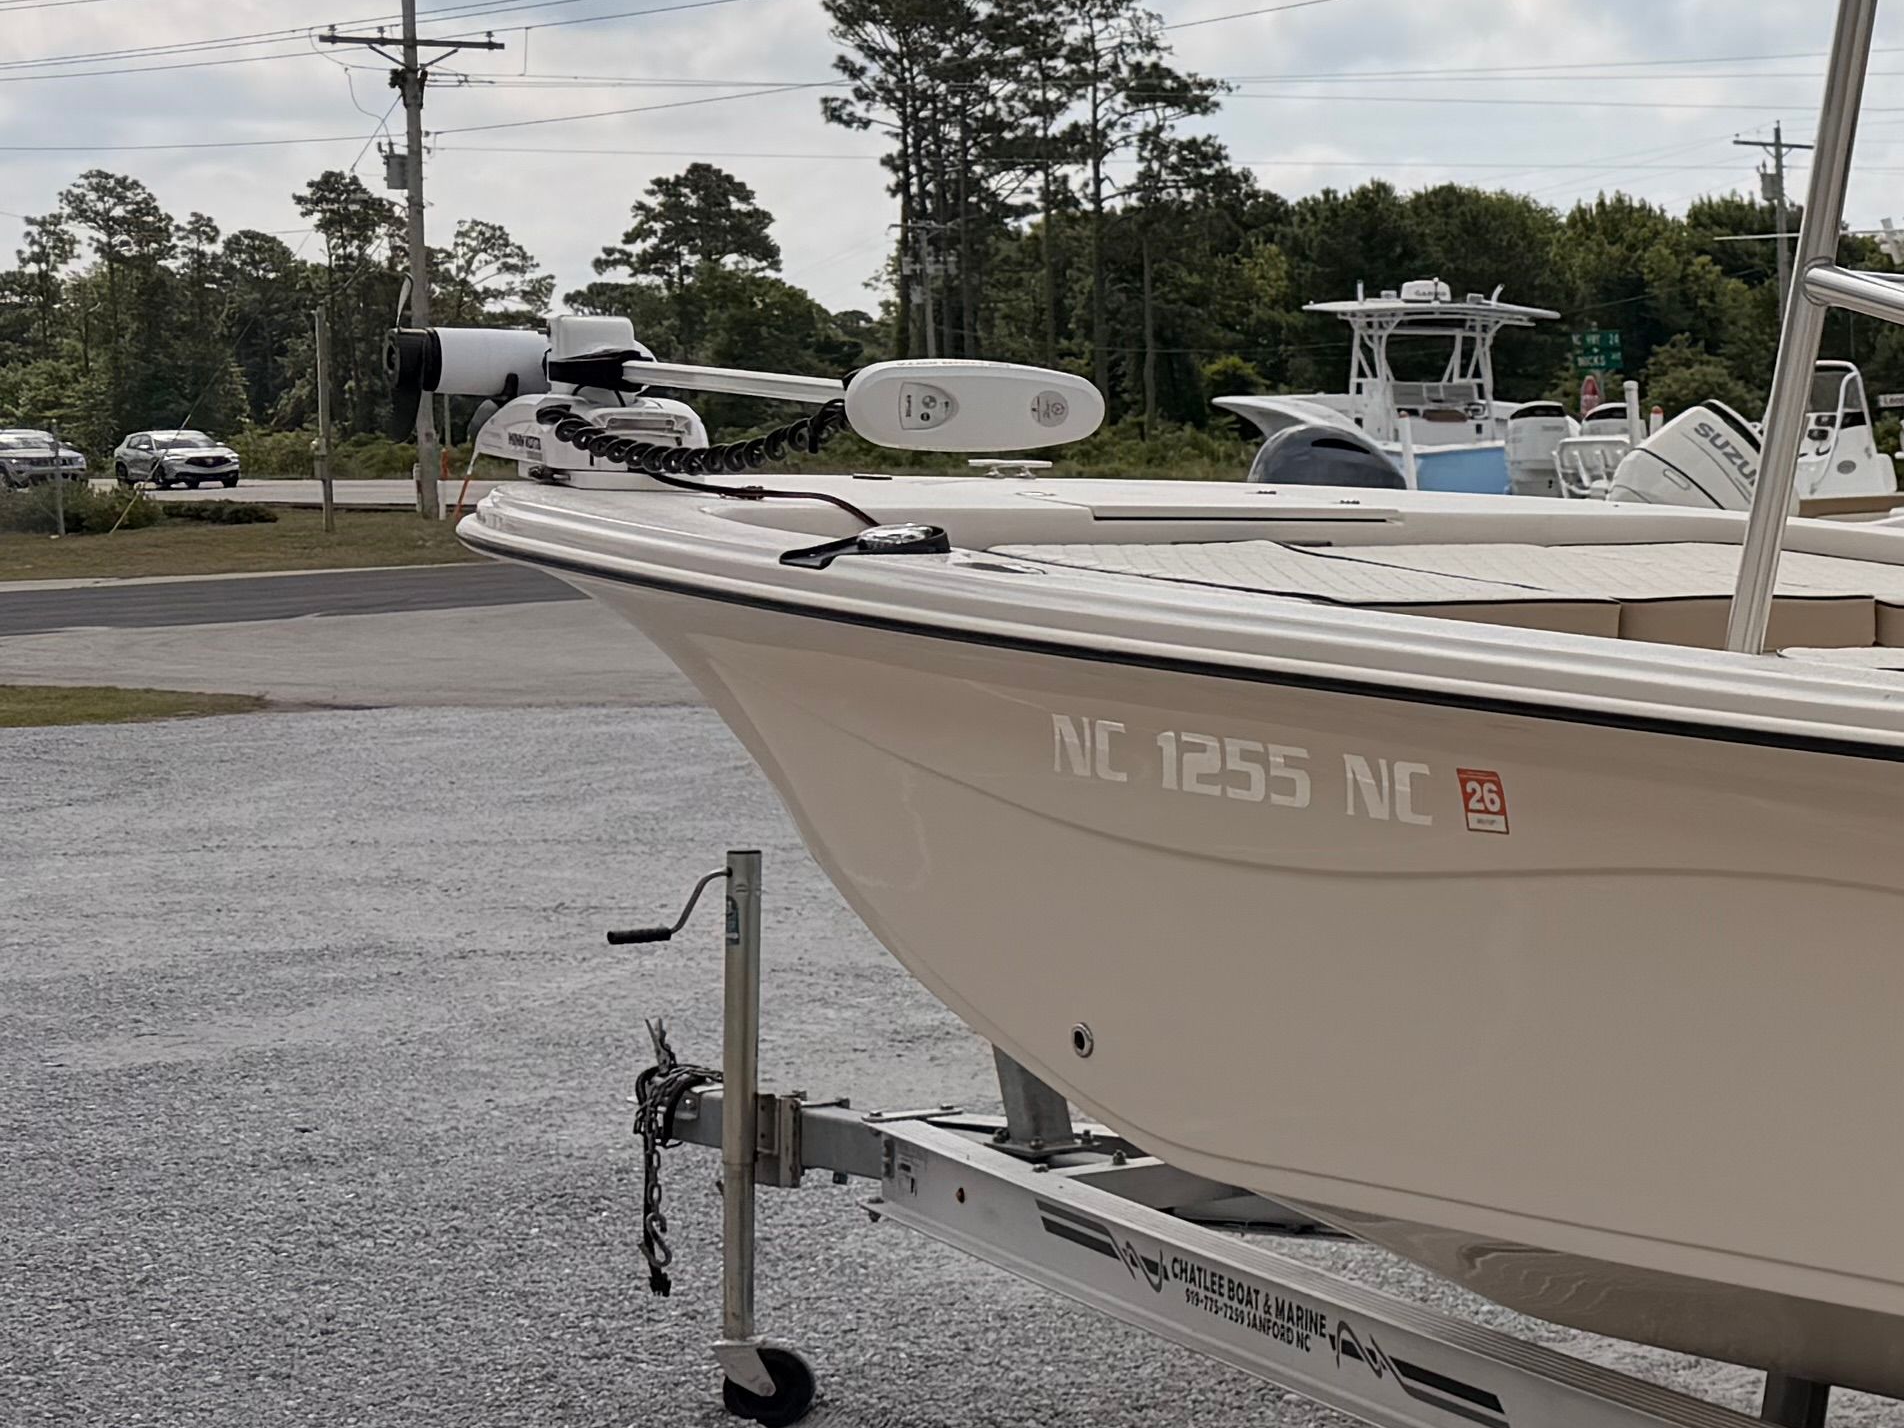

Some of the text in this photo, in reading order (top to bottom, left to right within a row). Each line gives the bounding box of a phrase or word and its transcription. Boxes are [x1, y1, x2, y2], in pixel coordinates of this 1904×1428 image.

[1693, 422, 1758, 487] SUZU
[1051, 713, 1434, 827] NC 1255 NC
[1466, 780, 1501, 812] 26
[1171, 1257, 1327, 1339] CHATLEE BOAT & MARINE
[1246, 1310, 1295, 1345] SANFORD
[1296, 1329, 1312, 1353] NC
